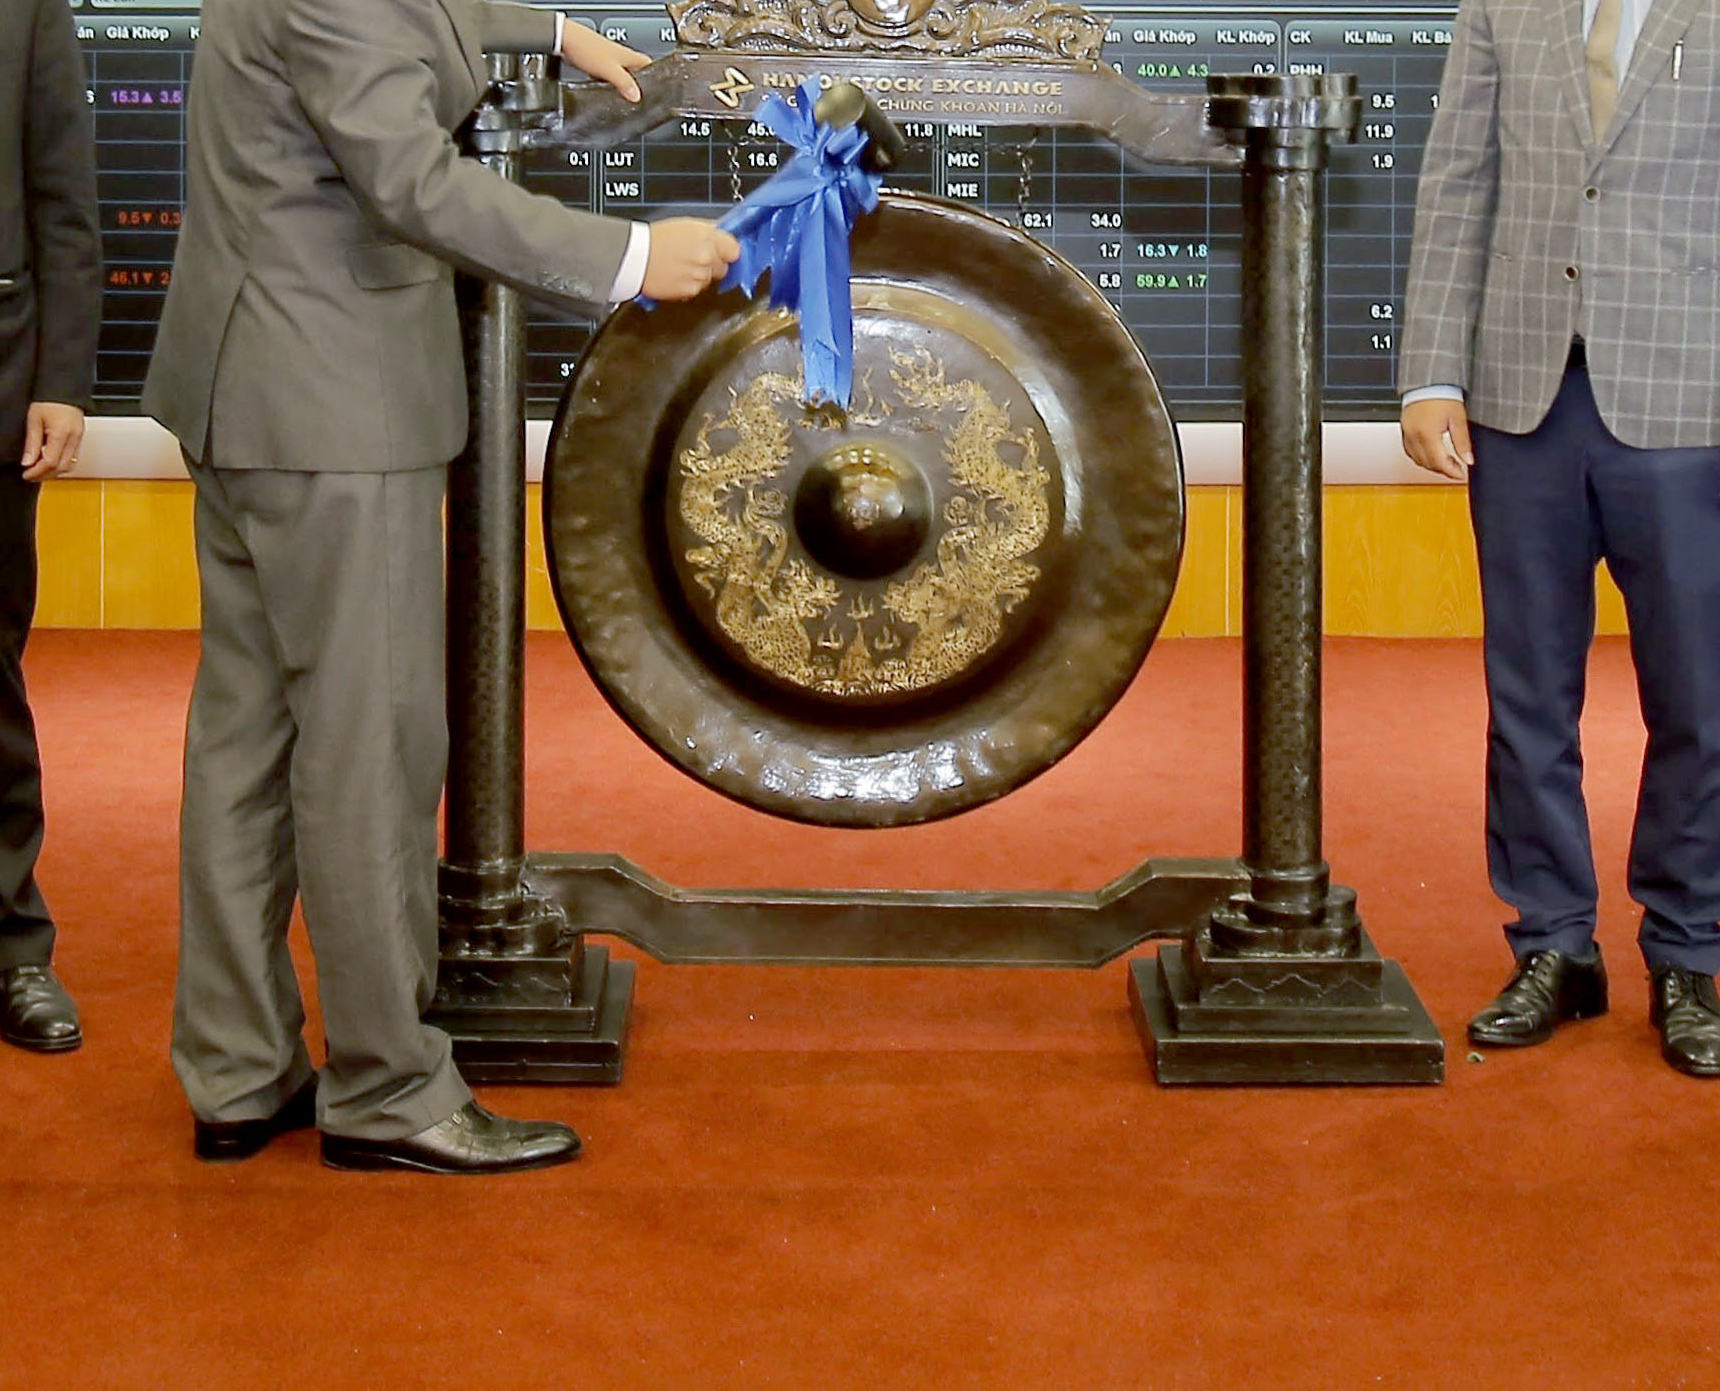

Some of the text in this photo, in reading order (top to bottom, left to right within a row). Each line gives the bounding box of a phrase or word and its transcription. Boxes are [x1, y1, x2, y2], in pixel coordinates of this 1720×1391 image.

[932, 78, 1063, 96] EXCHANGE
[1365, 125, 1394, 138] 11.9
[605, 153, 634, 166] LUT
[948, 153, 979, 167] MIC
[605, 183, 639, 197] LWS
[948, 183, 977, 197] MIE
[1090, 214, 1121, 228] 34.0
[1372, 335, 1391, 349] 1.1
